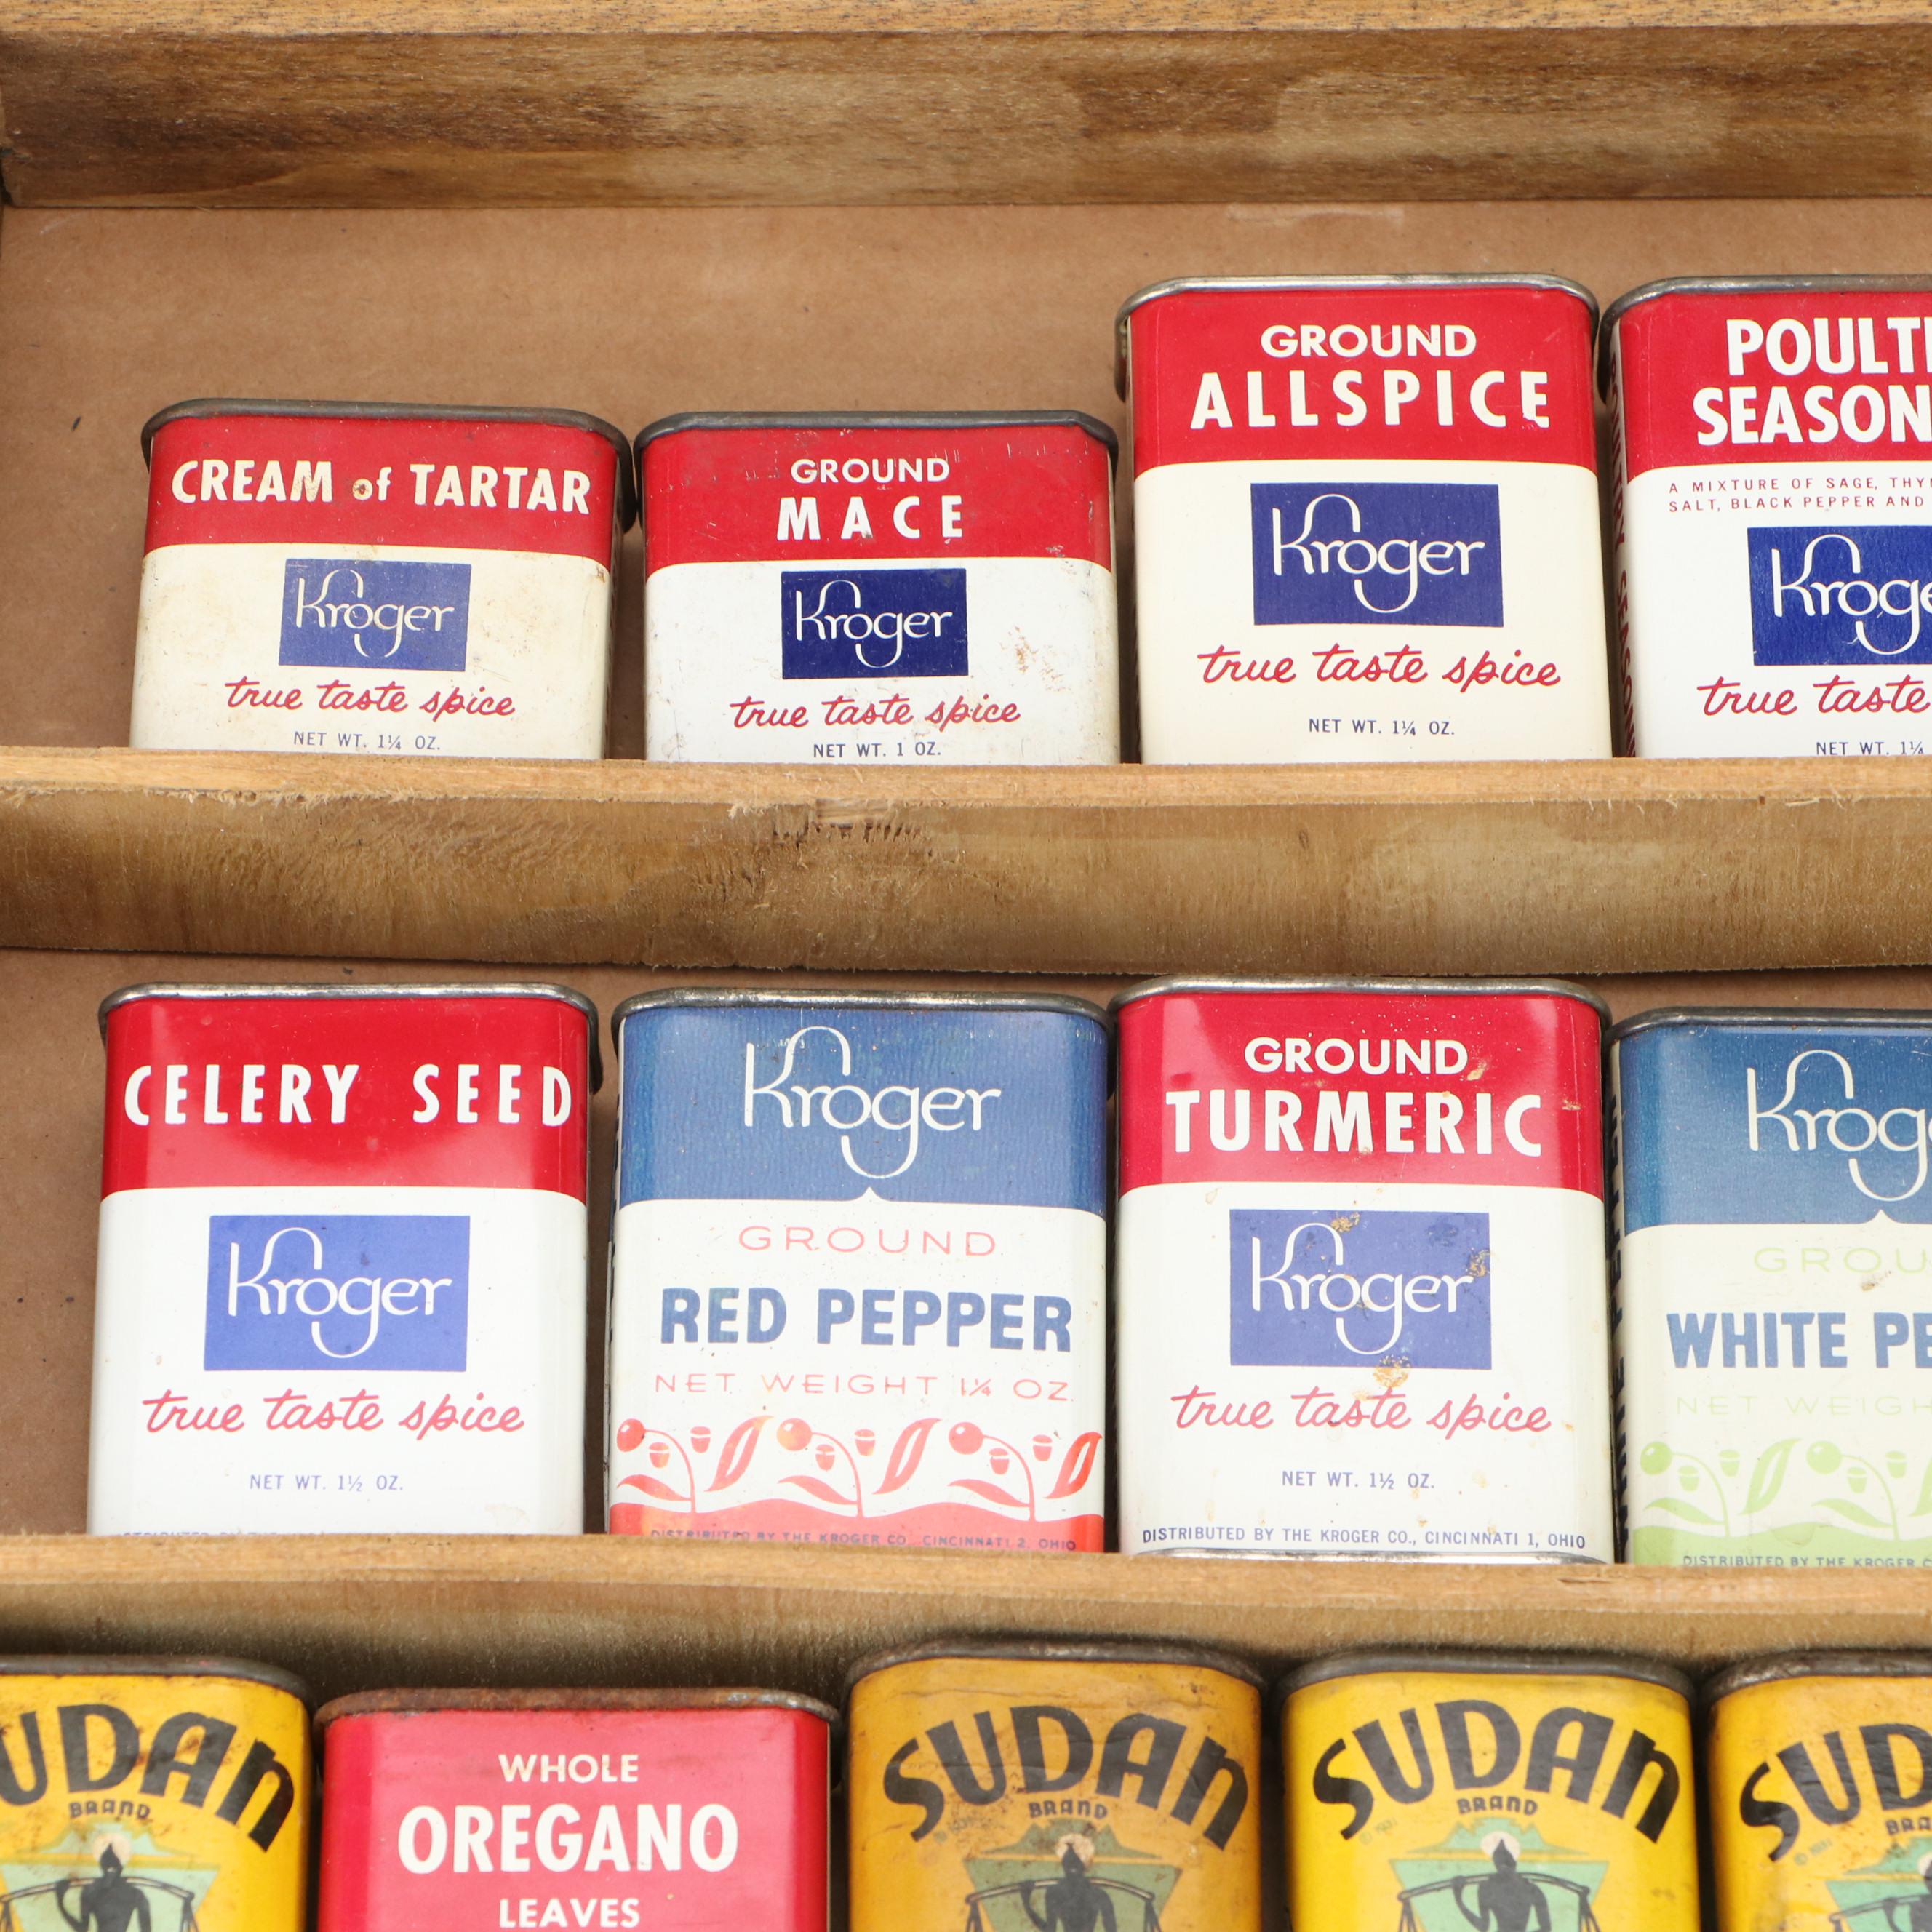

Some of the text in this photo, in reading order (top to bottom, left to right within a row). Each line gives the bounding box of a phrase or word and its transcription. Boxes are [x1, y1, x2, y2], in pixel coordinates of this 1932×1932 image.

[1261, 324, 1477, 357] GROUND
[1191, 370, 1550, 429] ALLSPICE
[1692, 384, 1932, 447] SEASON
[172, 459, 591, 515] CREAM of TARTAR
[790, 458, 949, 484] GROUND
[1669, 477, 1932, 493] A MIXTURE OF SAGE, THY
[776, 495, 963, 542] MACE
[1669, 495, 1925, 513] SALT, BLACK PEPPER AND
[1272, 493, 1485, 613] Kroger
[295, 569, 454, 658] Kroger
[795, 580, 953, 668] Kroger
[1197, 643, 1561, 692] true taste spice
[225, 676, 515, 722] true taste spice
[729, 693, 1021, 733] true taste spice
[1697, 674, 1931, 716] true taste
[293, 731, 326, 746] NET
[338, 733, 367, 748] WT.
[415, 735, 441, 751] OZ.
[1309, 719, 1341, 733] NET
[1352, 719, 1382, 735] WT.
[1429, 720, 1456, 736] OZ.
[1816, 741, 1848, 755] NET
[1859, 741, 1890, 755] WT.
[813, 741, 941, 758] NET WT. 1 OZ.
[1244, 1037, 1469, 1074] GROUND
[124, 1063, 572, 1127] CELERY SEED
[745, 1025, 1002, 1179] Kroger
[1166, 1089, 1542, 1157] TURMERIC
[1747, 1049, 1932, 1202] Krog
[739, 1226, 996, 1257] GROUND
[228, 1227, 452, 1359] Kroger
[1251, 1222, 1474, 1355] Kroger
[660, 1287, 1072, 1353] RED PEPPER
[1666, 1312, 1848, 1368] WHITE
[655, 1373, 735, 1393] NET
[762, 1373, 935, 1395] WEIGHT
[142, 1389, 524, 1440] true taste spice
[1170, 1384, 1552, 1440] true taste spice
[1676, 1396, 1758, 1416] NET
[249, 1475, 284, 1490] NET
[295, 1475, 326, 1490] WT.
[376, 1475, 403, 1490] OZ.
[1282, 1470, 1315, 1487] NET
[1326, 1472, 1359, 1488] WT.
[1408, 1472, 1435, 1489] OZ.
[651, 1530, 750, 1540] DISTRIBUTED
[757, 1532, 775, 1541] BY
[783, 1532, 811, 1542] THE
[819, 1533, 879, 1545] KROGER
[1039, 1538, 1076, 1551] OHIO
[1143, 1527, 1585, 1549] DISTRIBUTED BY THE KROGER CO., CINCINNATI 1, OHIO
[1683, 1555, 1784, 1567] DISTRIBUTED
[1790, 1556, 1808, 1567] BY
[1816, 1557, 1845, 1568] THE
[1854, 1558, 1915, 1568] KROGER
[498, 1755, 638, 1783] WHOLE
[397, 1803, 739, 1875] OREGANO
[499, 1898, 640, 1928] LEAVES
